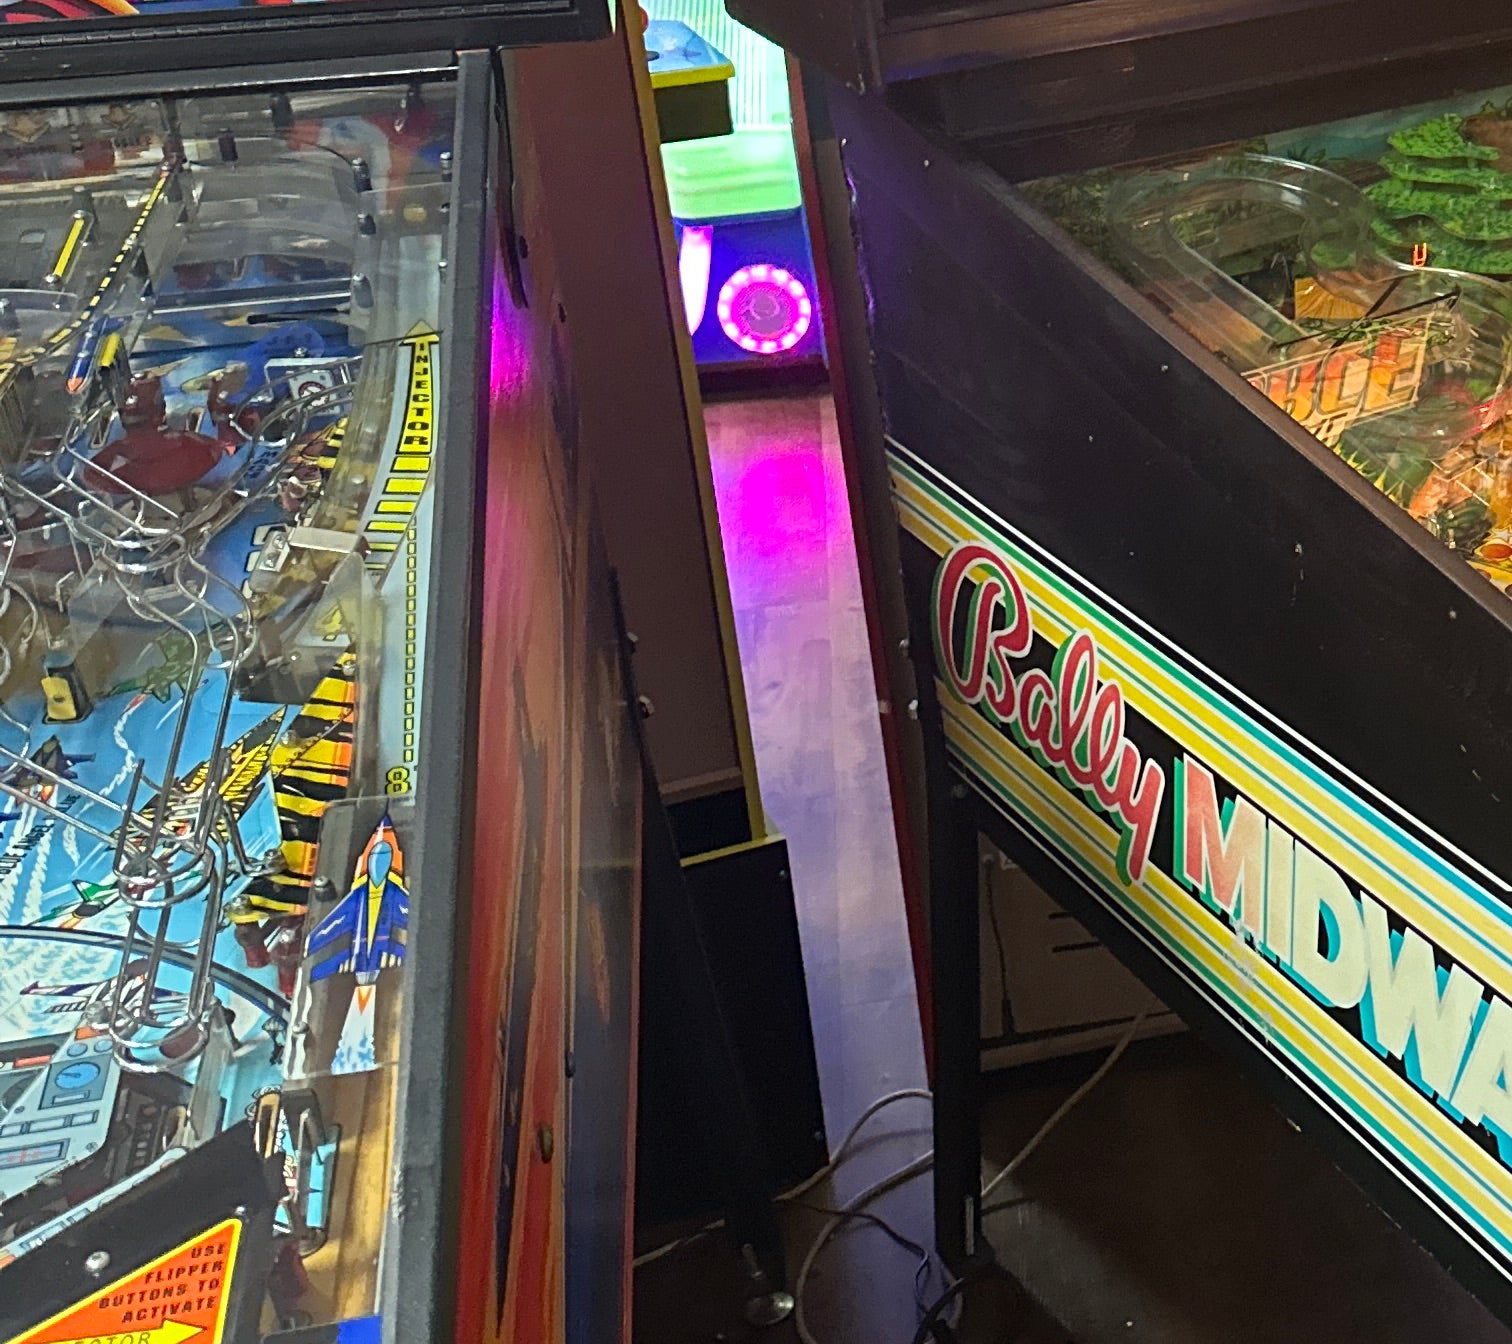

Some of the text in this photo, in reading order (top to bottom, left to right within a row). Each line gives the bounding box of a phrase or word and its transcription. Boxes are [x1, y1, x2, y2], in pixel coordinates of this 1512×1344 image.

[403, 343, 430, 446] INJECTOR
[932, 542, 1166, 887] Bally
[191, 1243, 226, 1259] USE
[145, 1260, 225, 1285] FLIPPER
[99, 1278, 221, 1309] BUTTONS TO
[122, 1296, 217, 1324] ACTIVATE
